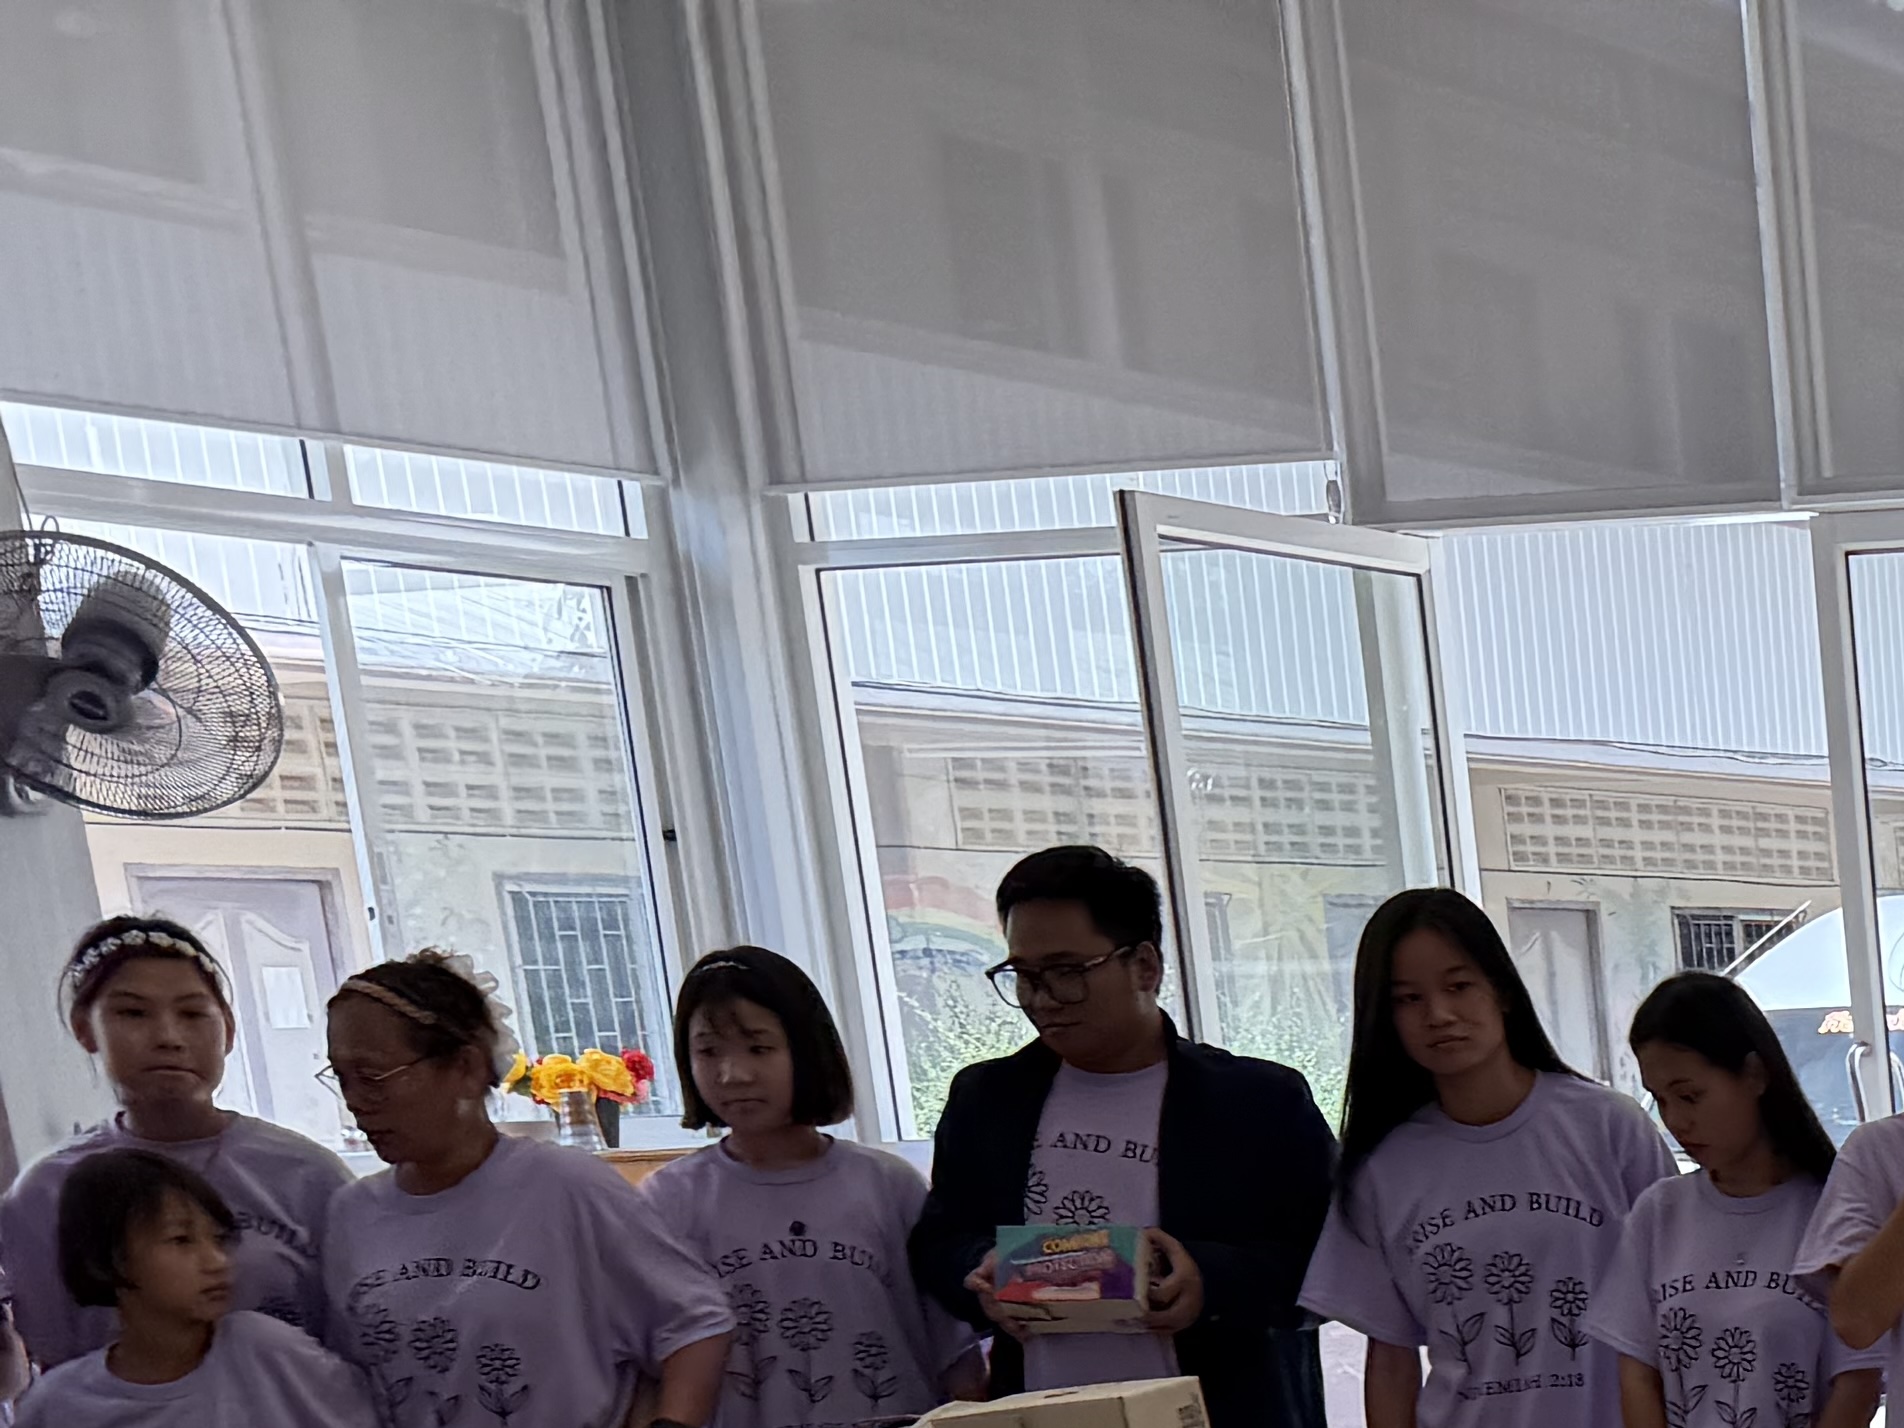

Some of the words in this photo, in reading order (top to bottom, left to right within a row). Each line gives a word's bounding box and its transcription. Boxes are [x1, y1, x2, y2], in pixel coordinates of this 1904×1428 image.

[1050, 1132, 1112, 1154] AND
[1464, 1194, 1517, 1221] AND
[759, 1239, 818, 1260] AND
[1705, 1270, 1758, 1290] AND
